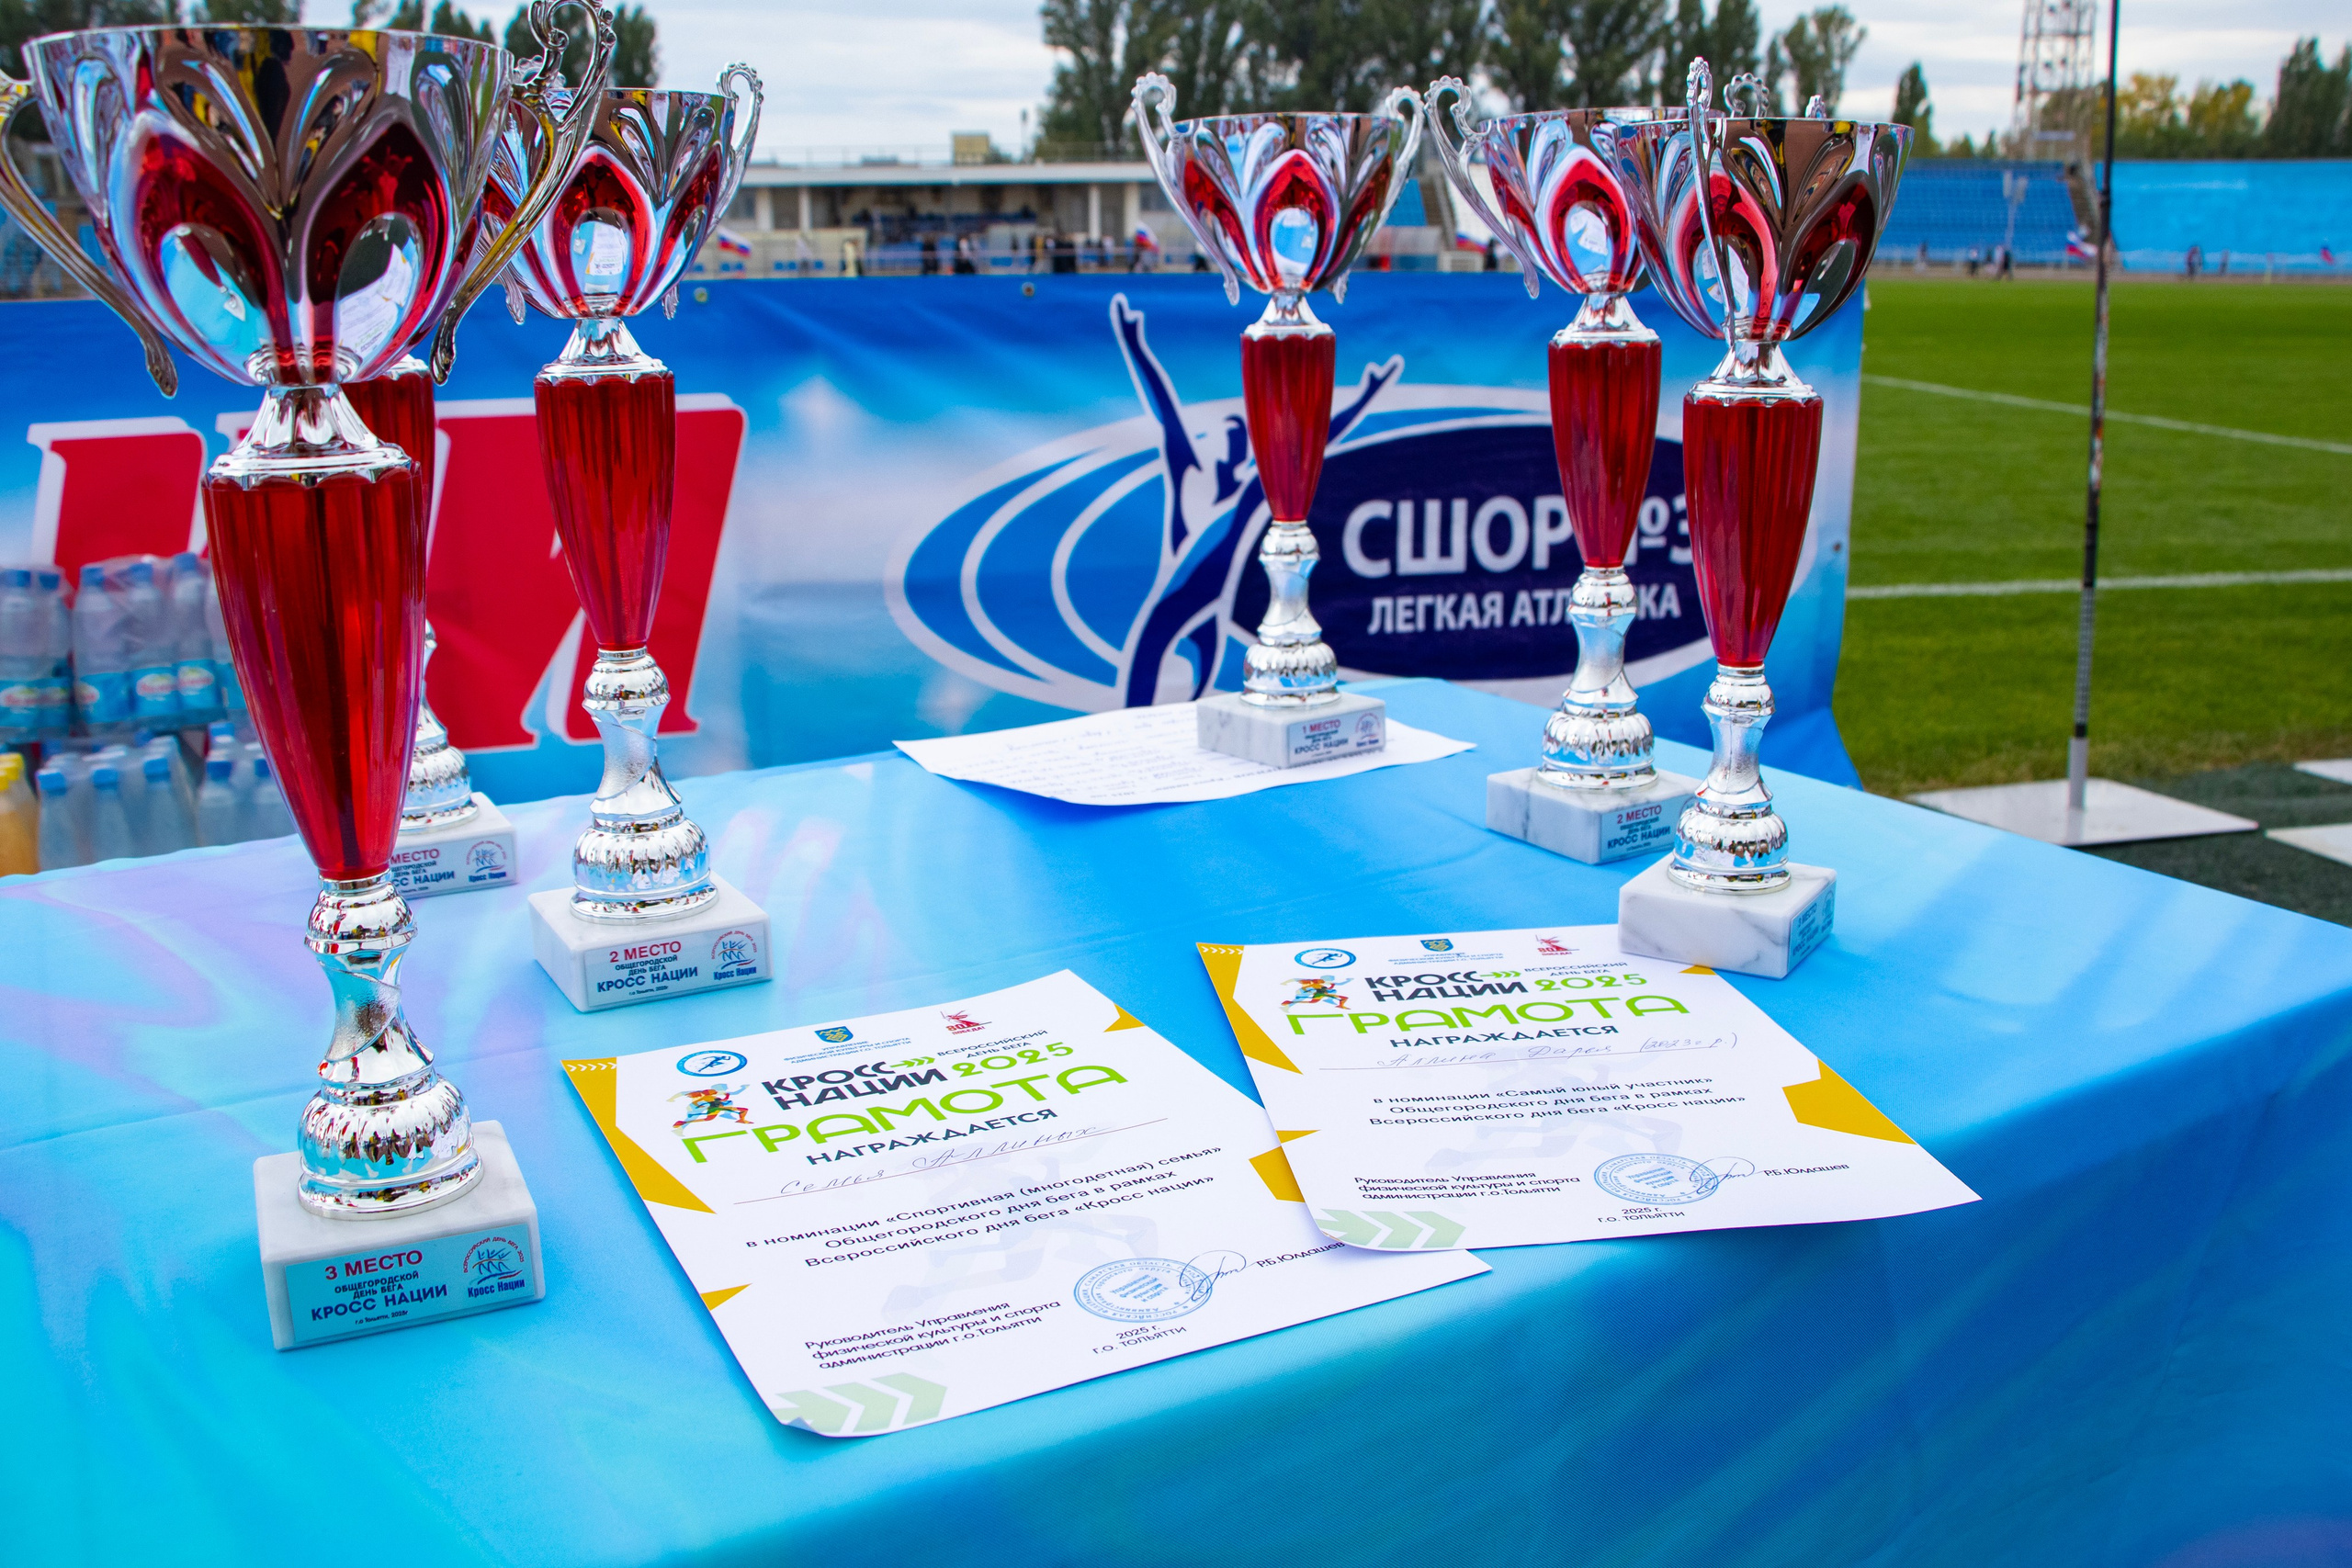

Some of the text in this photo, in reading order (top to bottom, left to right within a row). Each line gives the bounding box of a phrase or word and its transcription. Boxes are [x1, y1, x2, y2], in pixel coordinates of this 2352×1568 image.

[1342, 495, 1575, 578] СШОР
[1368, 583, 1681, 636] ЛЕГКАЯ АТЛКА
[1309, 718, 1341, 732] МЕСТО
[1617, 814, 1623, 824] 2
[1625, 805, 1662, 822] МЕСТО
[1607, 834, 1638, 850] КРОСС
[1641, 826, 1671, 840] НАЦИИ
[390, 848, 440, 865] МЕСТО
[391, 861, 436, 873] ЩЕГОРОДСКОЙ
[413, 871, 455, 886] НАЦИИ
[609, 941, 682, 964] 2 МЕСТО
[615, 954, 678, 971] ОБЩЕГОРОДСКОЙ
[597, 976, 646, 992] КРОСС
[650, 966, 698, 984] НАЦИИ
[628, 964, 666, 976] ДЕНЬ БЕГА
[713, 966, 757, 980] Кросс Нации
[1364, 971, 1485, 989] КРОСС
[1524, 962, 1628, 973] ВСЕРОССИЙСКИЙ
[1373, 974, 1647, 1002] НАЦИИ 2025
[1286, 995, 1690, 1035] ГРАМОТА
[936, 1030, 1048, 1057] ВСЕРОССИЙСКИЙ
[1389, 1025, 1620, 1048] НАГРАЖДАЕТСЯ
[966, 1041, 1032, 1059] ДЕНЬ БЕГА
[761, 1061, 898, 1096] КРОСС
[773, 1042, 1074, 1111] НАЦИИ 2025
[1388, 1092, 1490, 1103] номинации
[1496, 1085, 1567, 1099] «Самый
[1572, 1082, 1621, 1091] юный
[1624, 1077, 1713, 1091] участник»
[1389, 1098, 1548, 1114] Общегородского
[1554, 1096, 1585, 1106] дня
[1589, 1092, 1630, 1103] бега
[1651, 1088, 1713, 1100] рамках
[681, 1065, 1129, 1164] ГРАМОТА
[1369, 1094, 1747, 1126] Всероссийского дня бега «Кросс нации»
[806, 1109, 1058, 1166] НАГРАЖДАЕТСЯ
[781, 1168, 887, 1194] Семья
[1354, 1172, 1536, 1186] Руководитель Управления
[1763, 1163, 1850, 1177] Р.Б.Юлдашев
[746, 1145, 1223, 1248] в номинации «Спортивная (многодетная) семья»
[1358, 1184, 1446, 1193] физической
[1451, 1181, 1513, 1191] культуры
[1529, 1177, 1580, 1186] спорта
[1363, 1190, 1476, 1201] администрации
[805, 1175, 1216, 1269] Всероссийского дня бега «Кросс нации»
[825, 1170, 1179, 1250] Общегородского дня бега в рамках
[1623, 1211, 1685, 1222] ТОЛЬЯТТИ
[324, 1249, 424, 1281] 3 МЕСТО
[1256, 1241, 1346, 1269] Р.Б.Юлдашев
[334, 1270, 419, 1294] ОБЩЕГОРОДСКОЙ
[353, 1283, 404, 1300] ДЕНЬ БЕГА
[468, 1279, 526, 1298] Кросс Нации
[311, 1284, 448, 1321] КРОСС НАЦИИ
[805, 1302, 1011, 1349] Руководитель Управления
[812, 1333, 915, 1360] физической
[918, 1318, 988, 1340] культуры
[1004, 1300, 1061, 1320] спорта
[1115, 1325, 1150, 1340] 2025
[820, 1316, 1042, 1370] администрации г.о.Тольятти
[1092, 1326, 1188, 1355] Г.О. ТОЛЬЯТТИ
